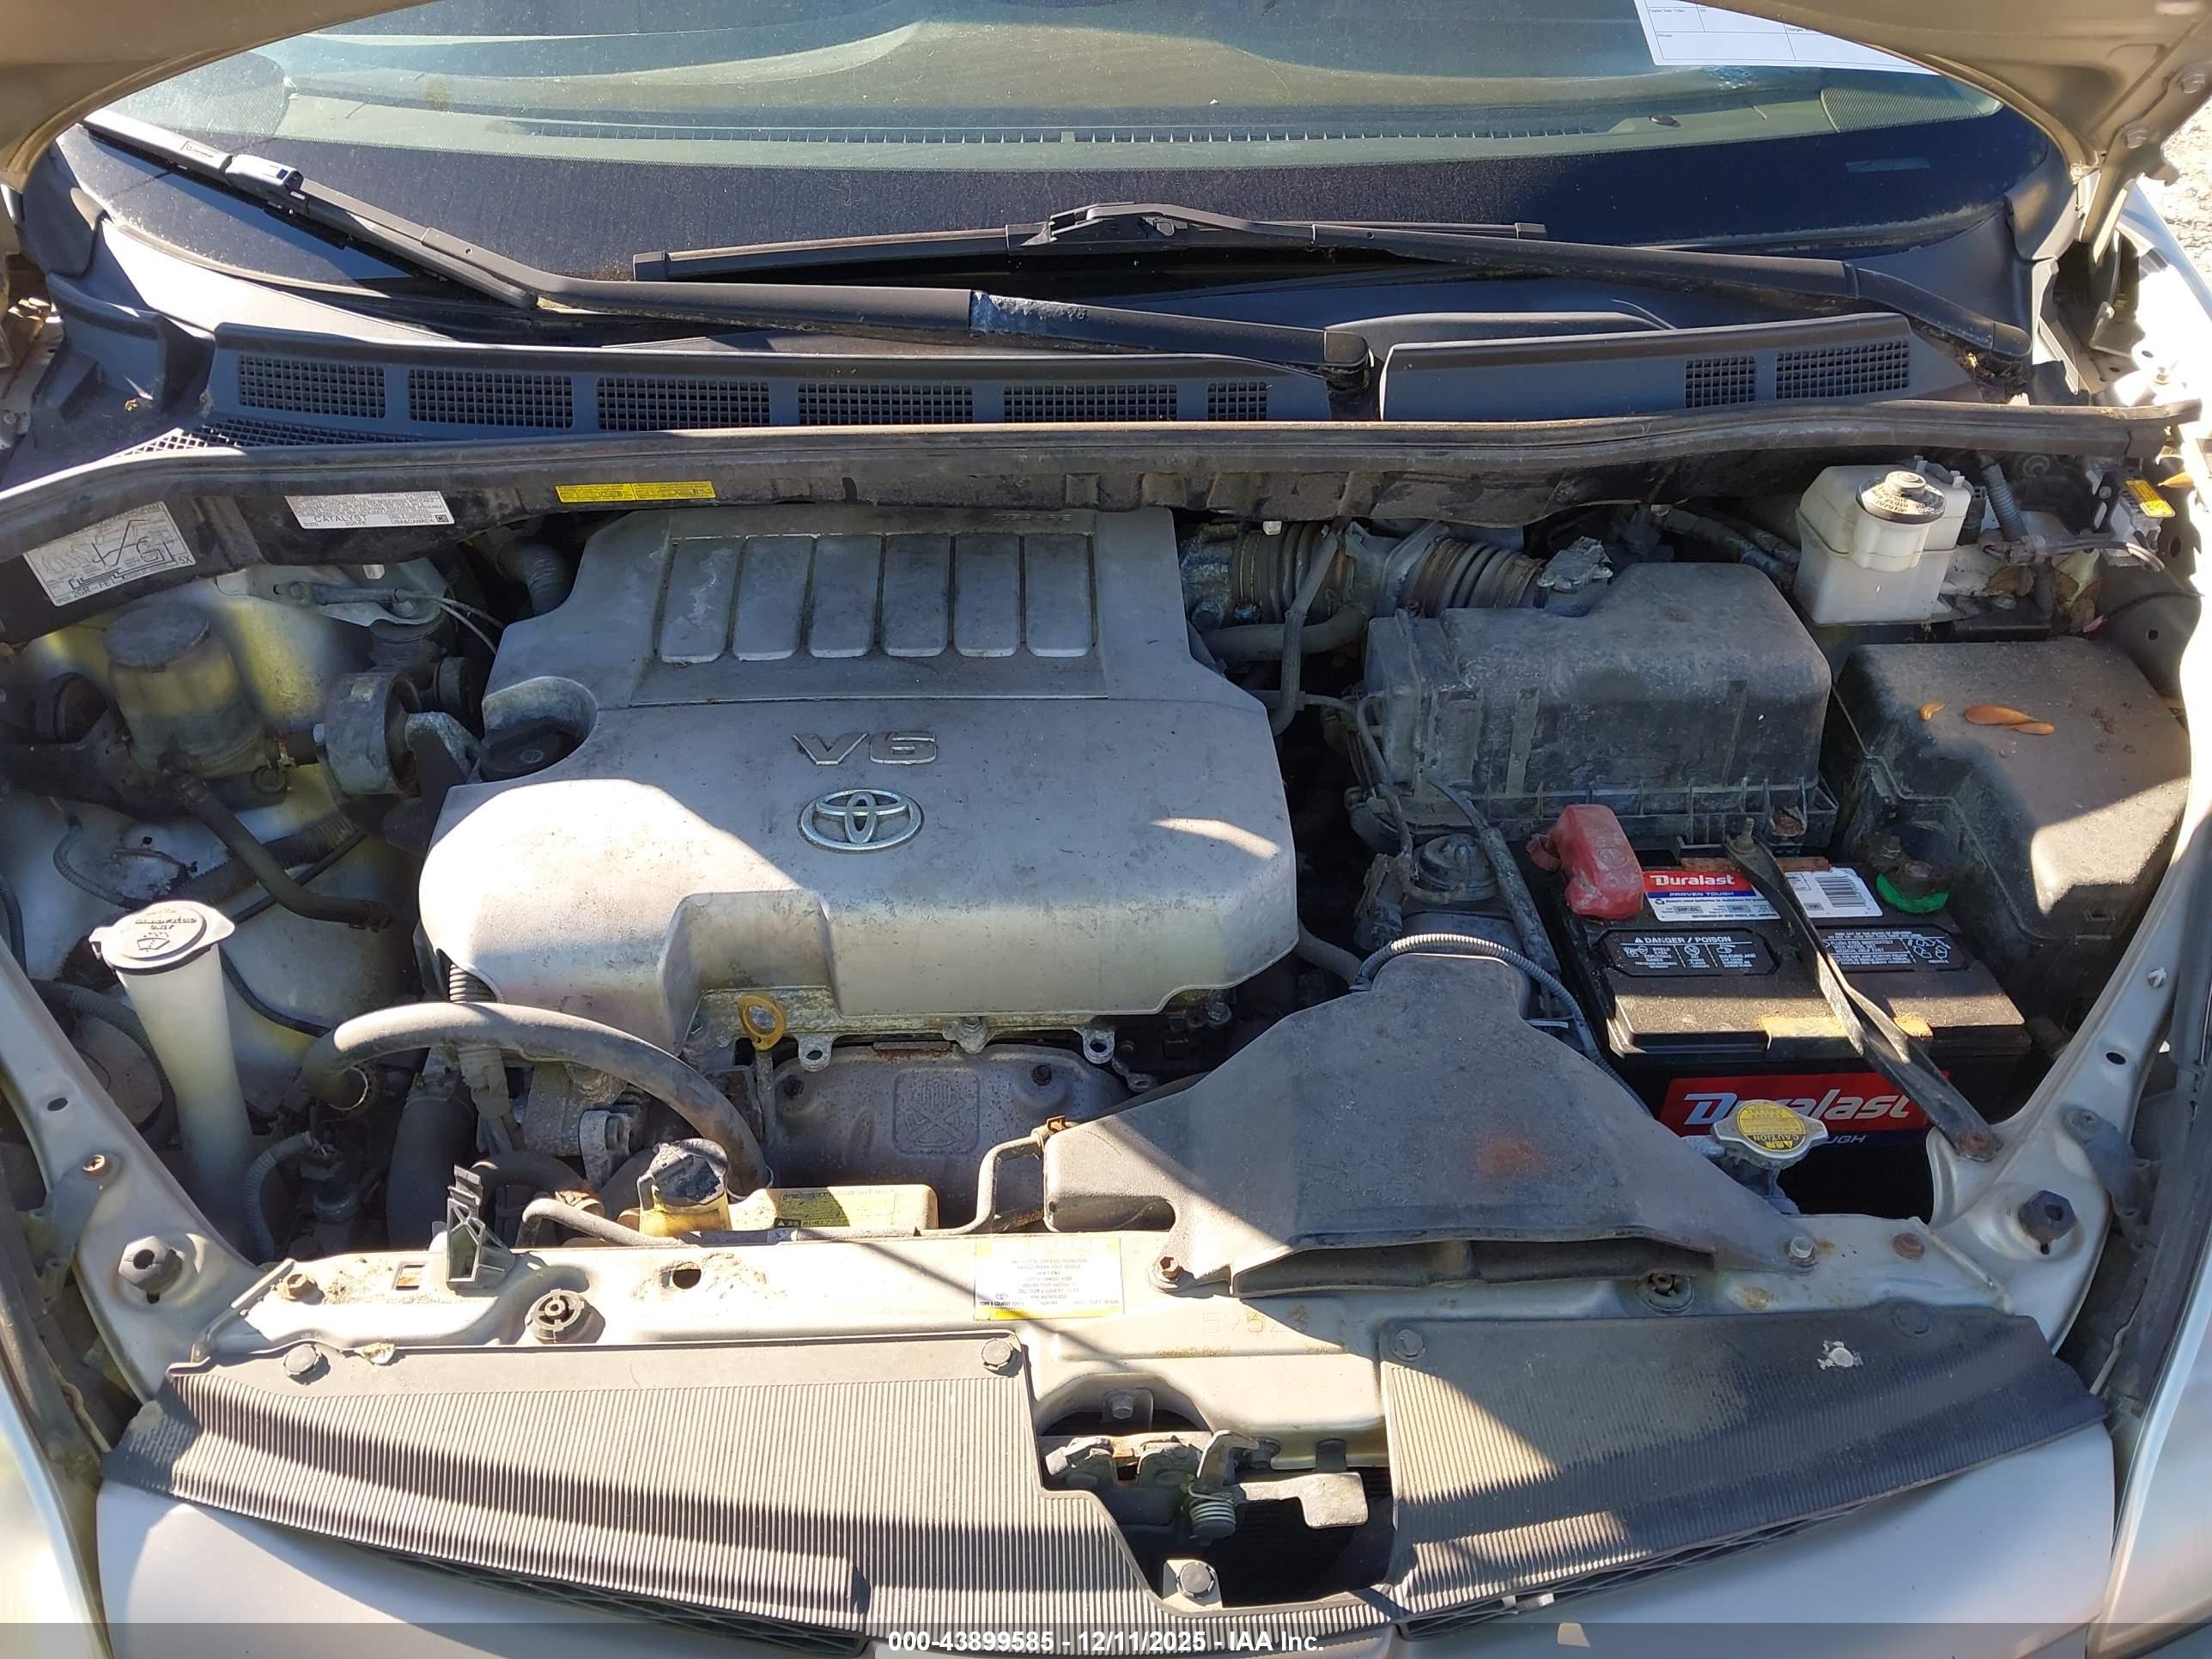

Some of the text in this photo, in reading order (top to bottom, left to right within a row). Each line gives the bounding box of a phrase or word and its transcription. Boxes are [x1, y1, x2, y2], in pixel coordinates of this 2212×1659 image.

[792, 730, 939, 765] V6
[1650, 874, 1735, 886] Duralast
[1684, 1089, 1911, 1125] Dalast
[1753, 1133, 1800, 1142] CAUTION
